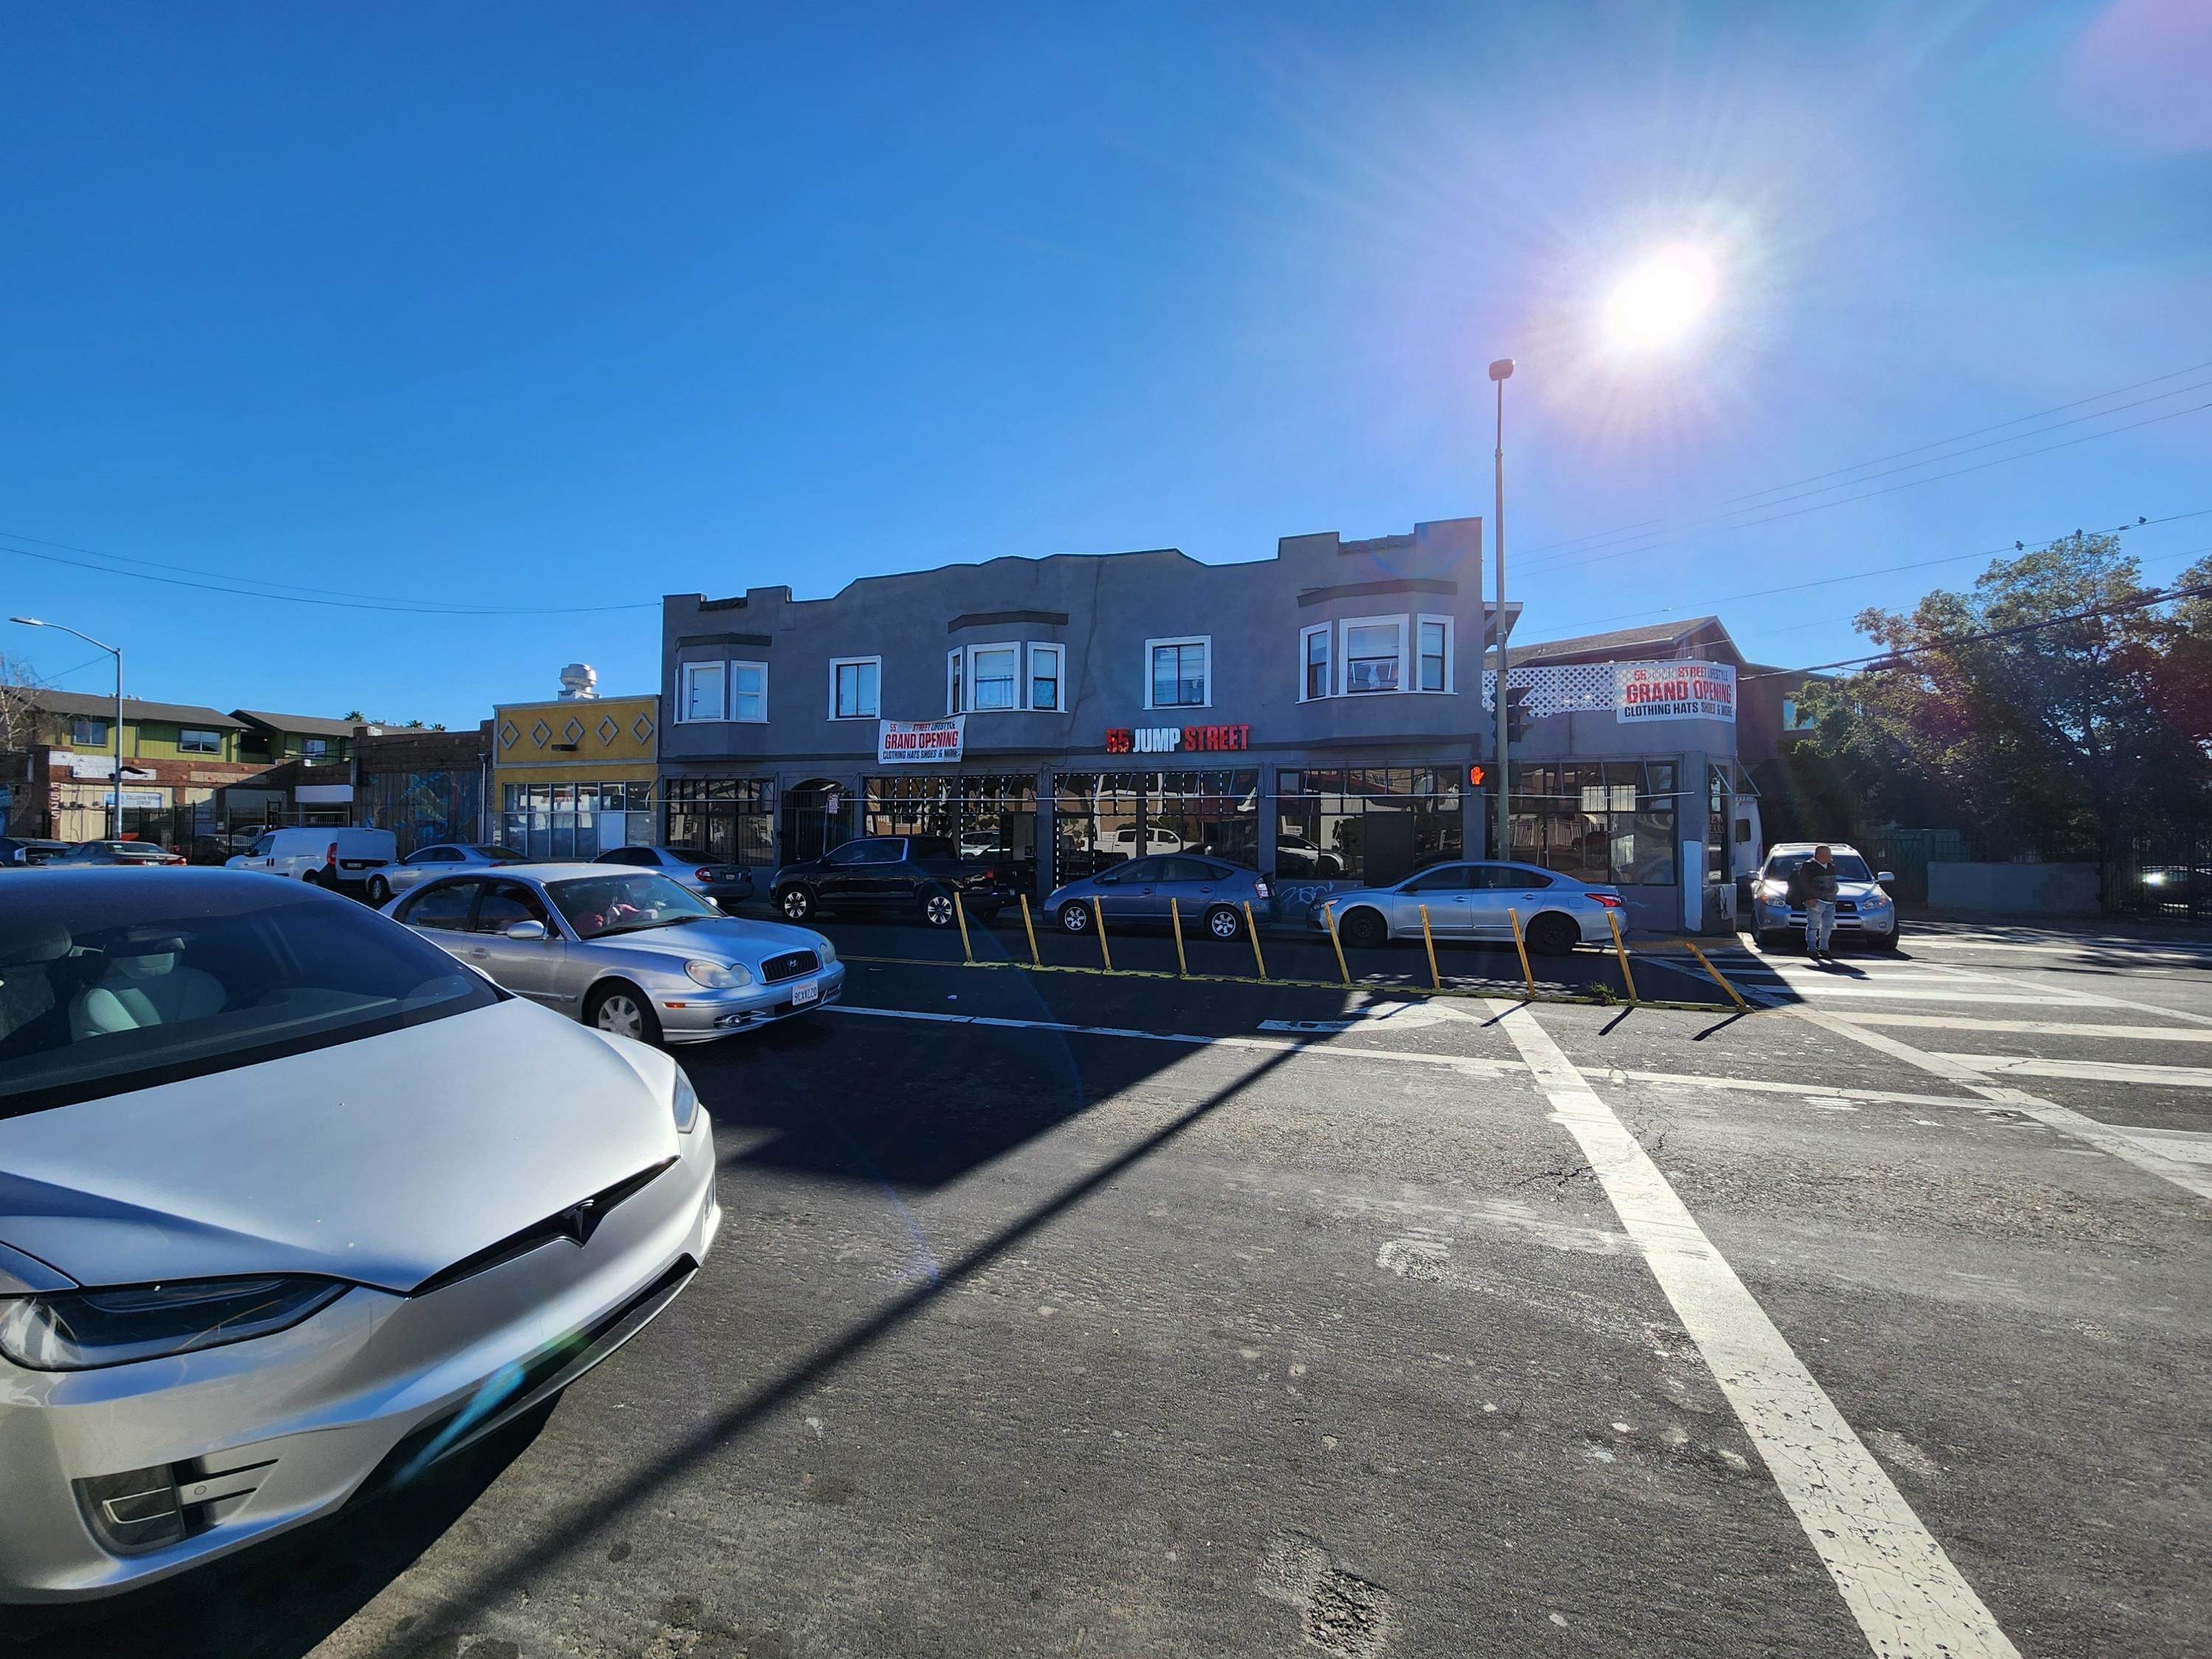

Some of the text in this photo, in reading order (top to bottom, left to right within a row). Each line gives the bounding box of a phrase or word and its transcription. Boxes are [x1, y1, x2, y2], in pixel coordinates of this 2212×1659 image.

[1634, 669, 1646, 681] 55
[1678, 666, 1707, 678] STREET
[1708, 667, 1728, 682] LIFESTYLE
[1627, 680, 1731, 704] GRAND OPENING
[1624, 703, 1671, 717] CLOTHING
[1673, 703, 1698, 714] HATS
[890, 723, 897, 732] 55
[912, 723, 931, 732] STREET
[931, 720, 956, 731] LIFESTYLE
[885, 731, 959, 750] GRAND OPENING
[1106, 724, 1249, 754] 55 JUMP STREET
[883, 751, 905, 760] CLOTHING
[906, 751, 920, 759] HATS
[920, 750, 936, 759] SHOES
